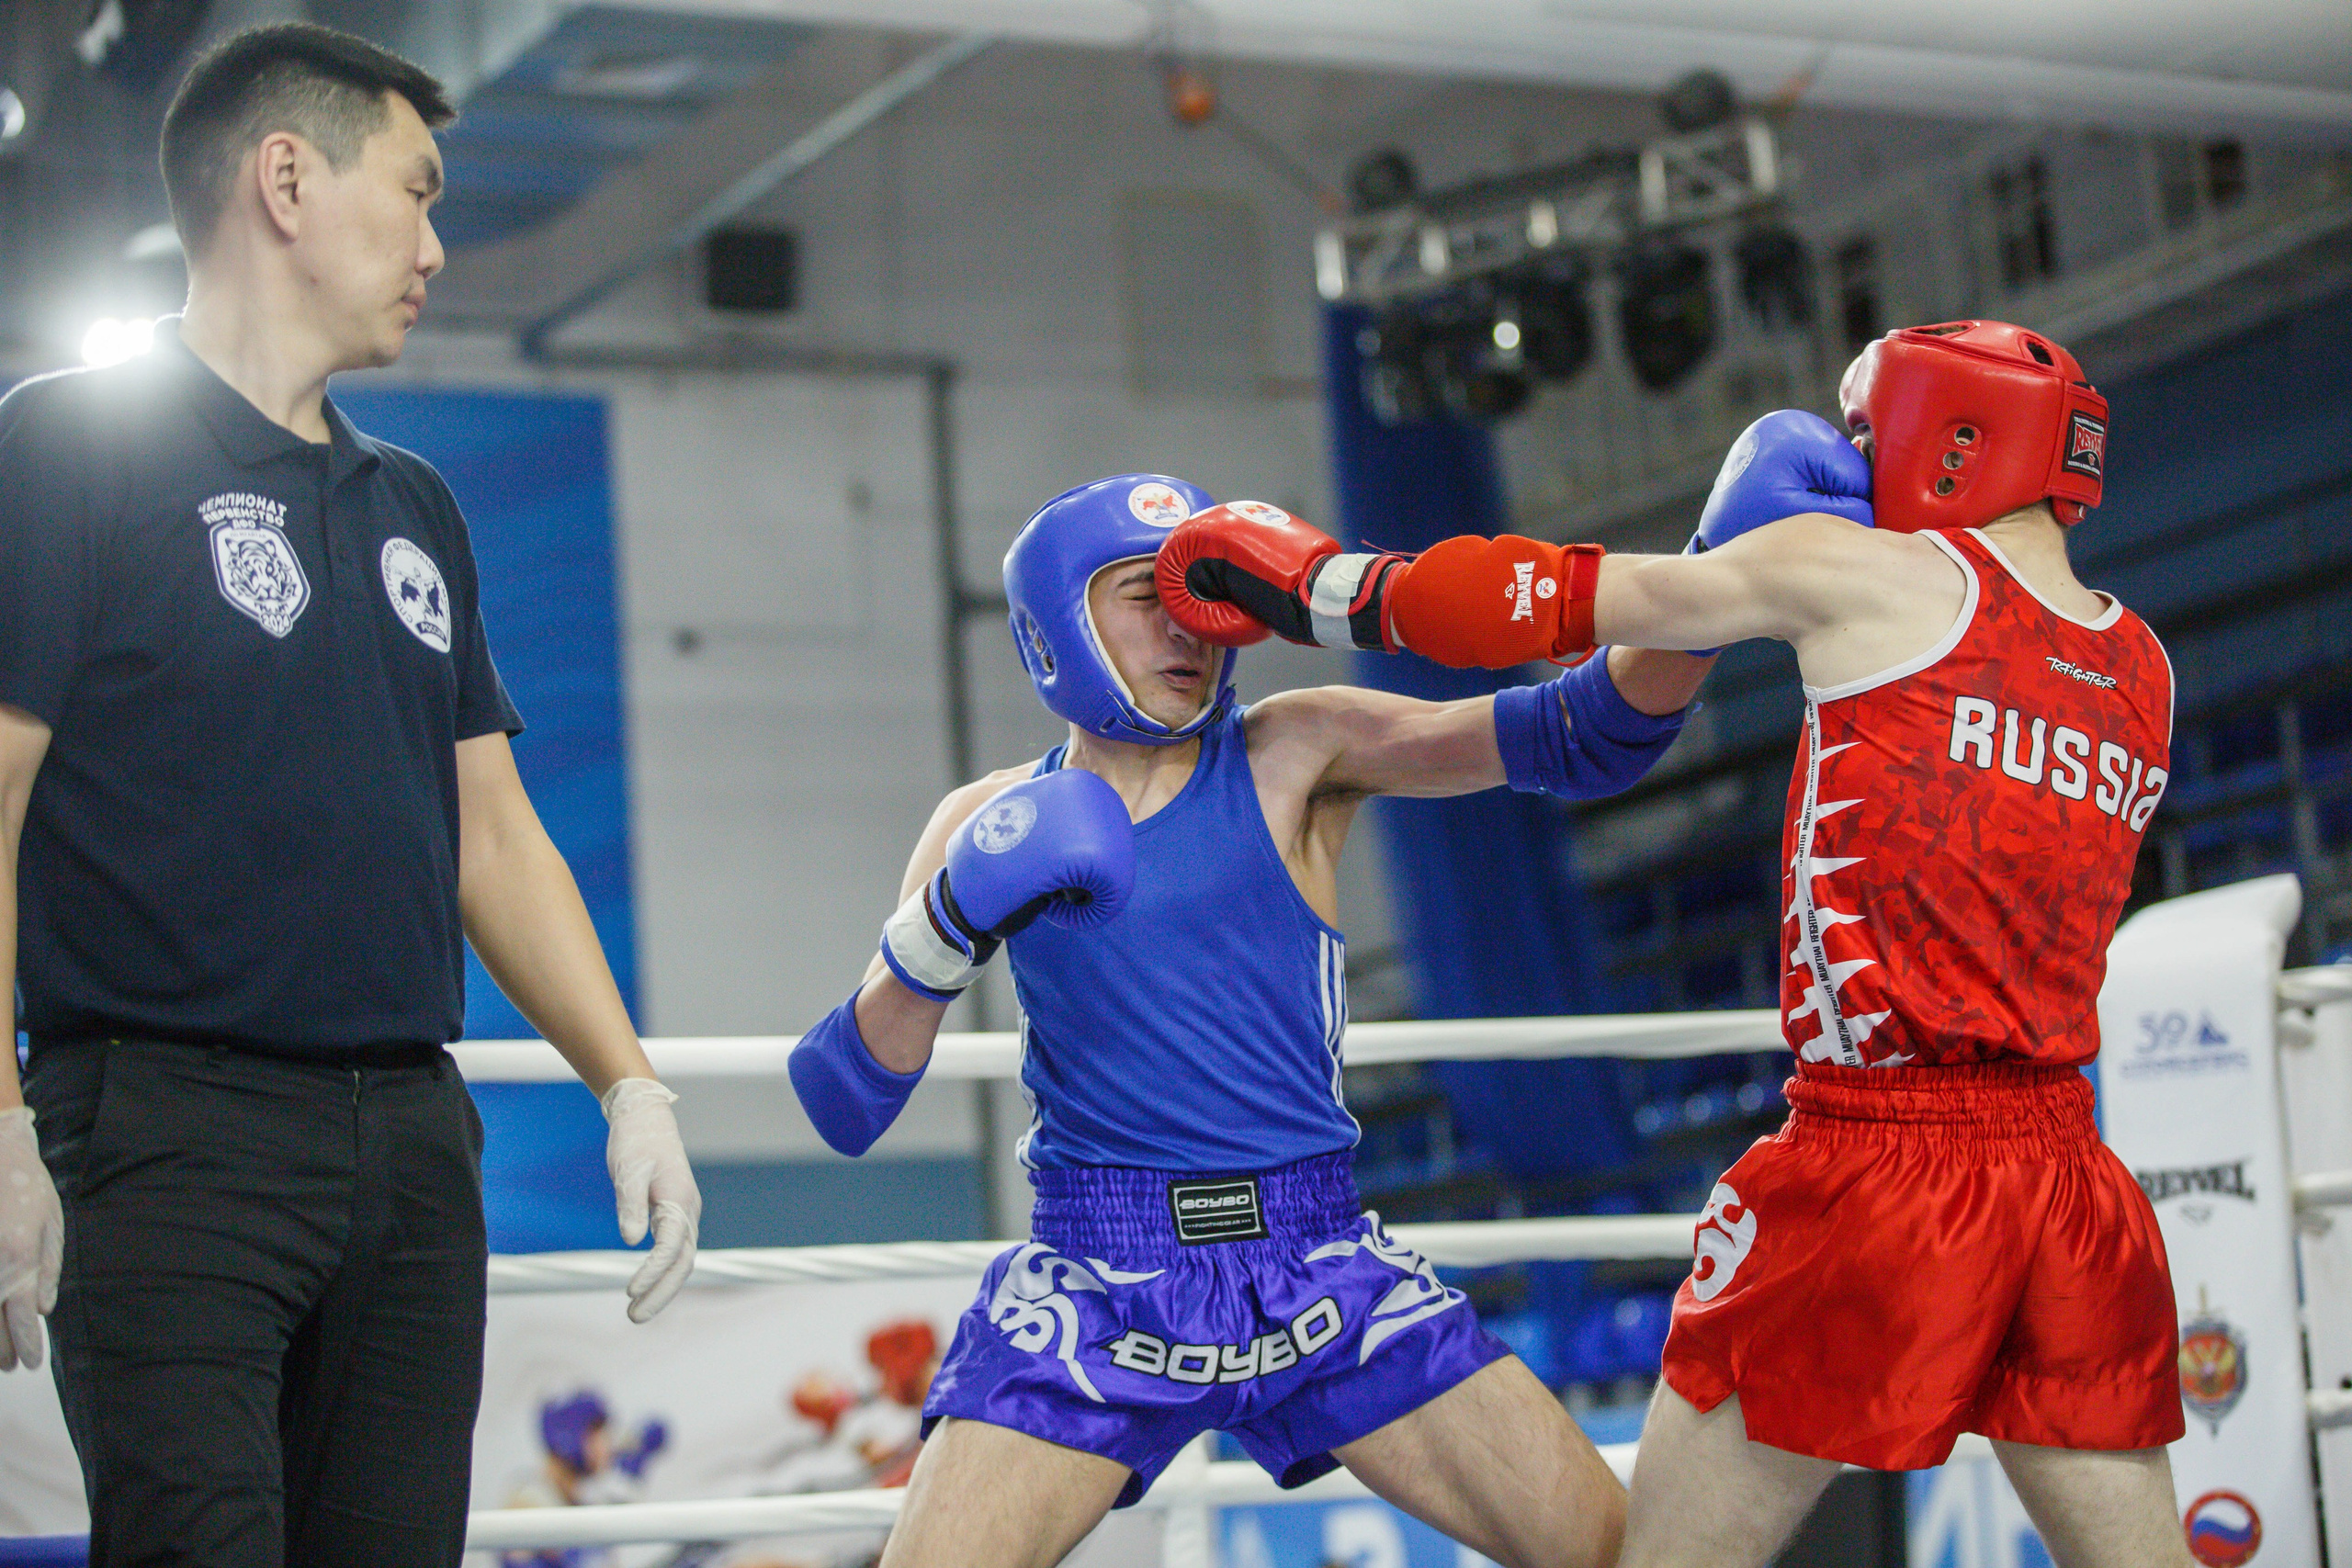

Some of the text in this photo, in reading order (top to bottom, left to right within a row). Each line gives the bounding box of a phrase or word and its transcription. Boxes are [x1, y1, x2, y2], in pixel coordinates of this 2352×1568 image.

[198, 492, 287, 516] ЧЕМПИОНАТ
[203, 507, 285, 528] ПЕРВЕНСТВО
[1510, 560, 1536, 621] REYVEL
[1813, 945, 1829, 982] MUAYTHAI
[1179, 1194, 1250, 1210] BOYBO
[1107, 1296, 1343, 1384] BOYBO
